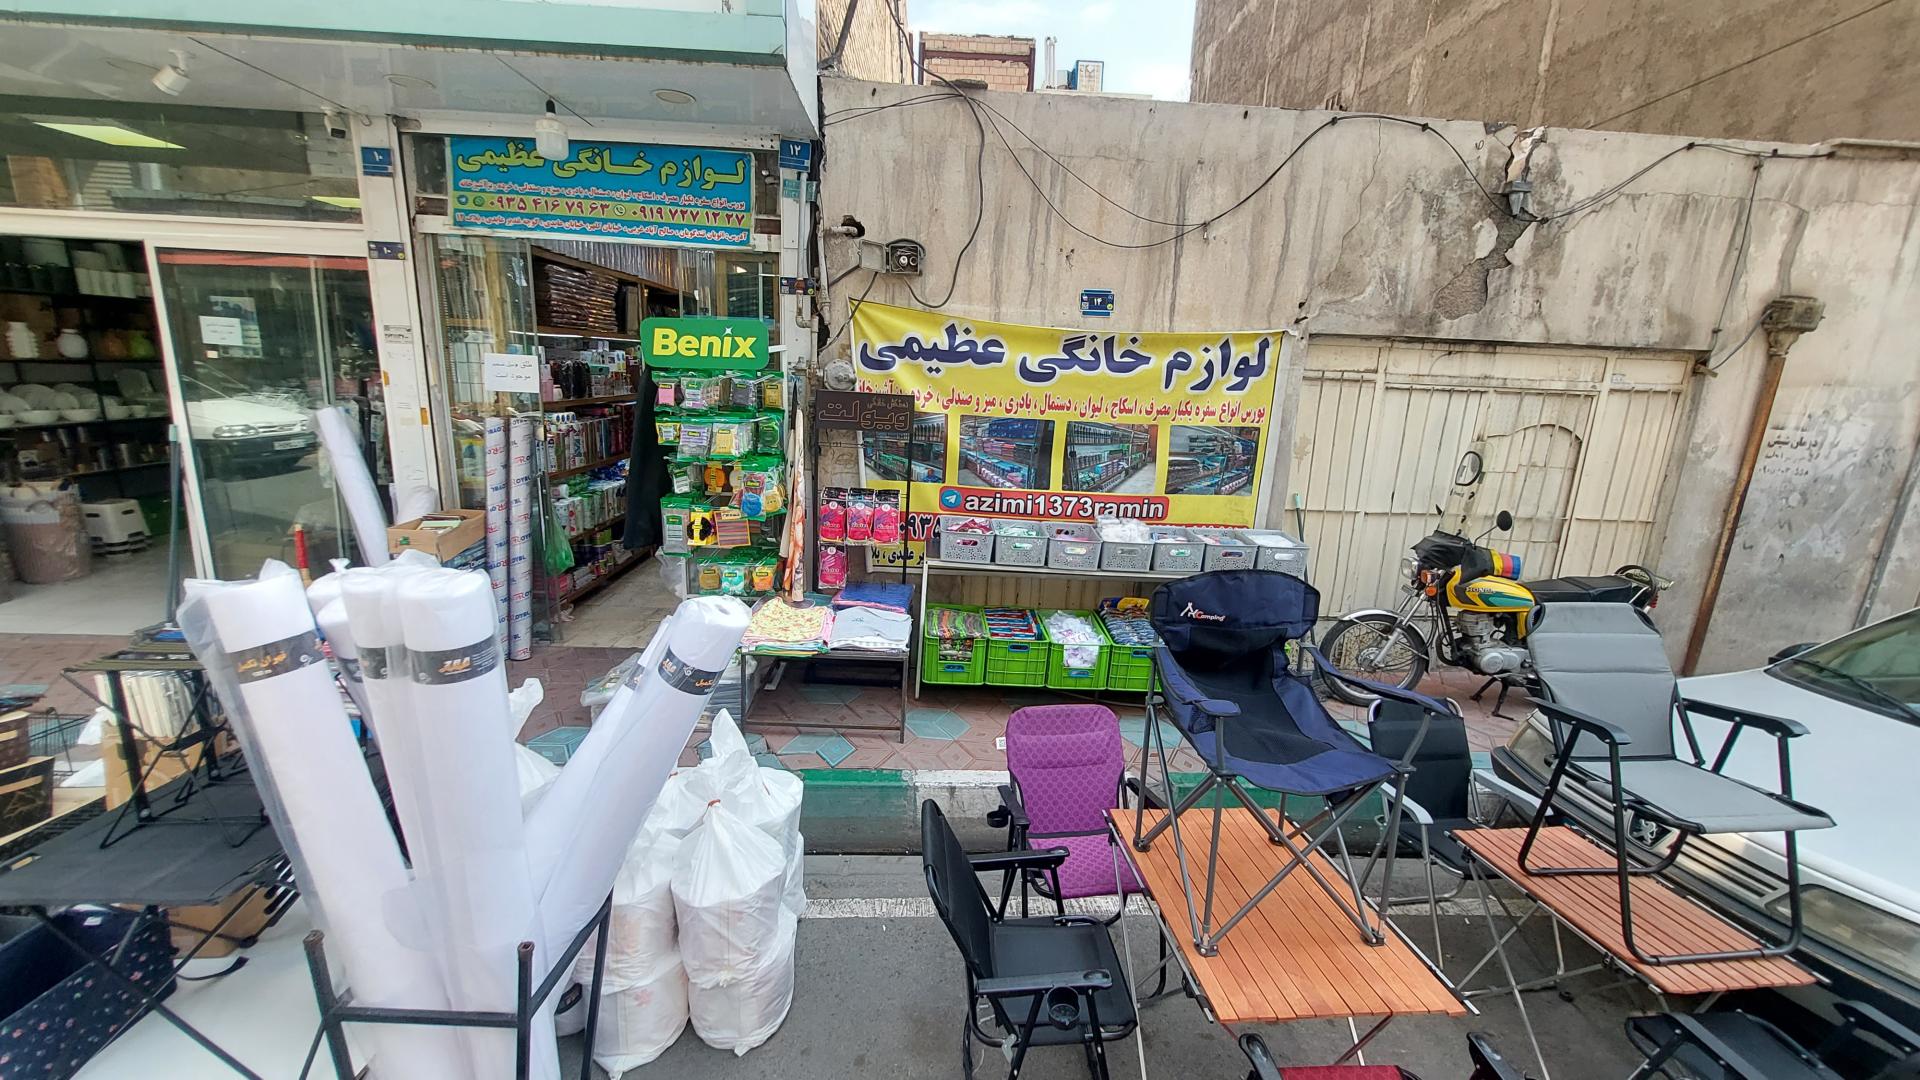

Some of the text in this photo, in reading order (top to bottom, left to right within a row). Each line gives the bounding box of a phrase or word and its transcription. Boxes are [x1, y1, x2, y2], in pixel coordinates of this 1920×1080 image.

[457, 141, 545, 173] عظیمی
[553, 148, 654, 178] خانگی
[659, 155, 746, 190] لوازم
[489, 195, 610, 216] ۰۹۳۵ ۴۱۶ ۷۹ ۶۳
[632, 205, 664, 220] ۰۹۱۹
[668, 208, 700, 223] ۷۲۷
[652, 326, 757, 359] Benix
[860, 322, 1270, 392] لوازم خانگی عظیمی
[1171, 400, 1193, 422] یکبار
[1219, 400, 1241, 423] انواع
[1241, 405, 1266, 424] بورس
[964, 492, 1164, 519] azimi1373ramin
